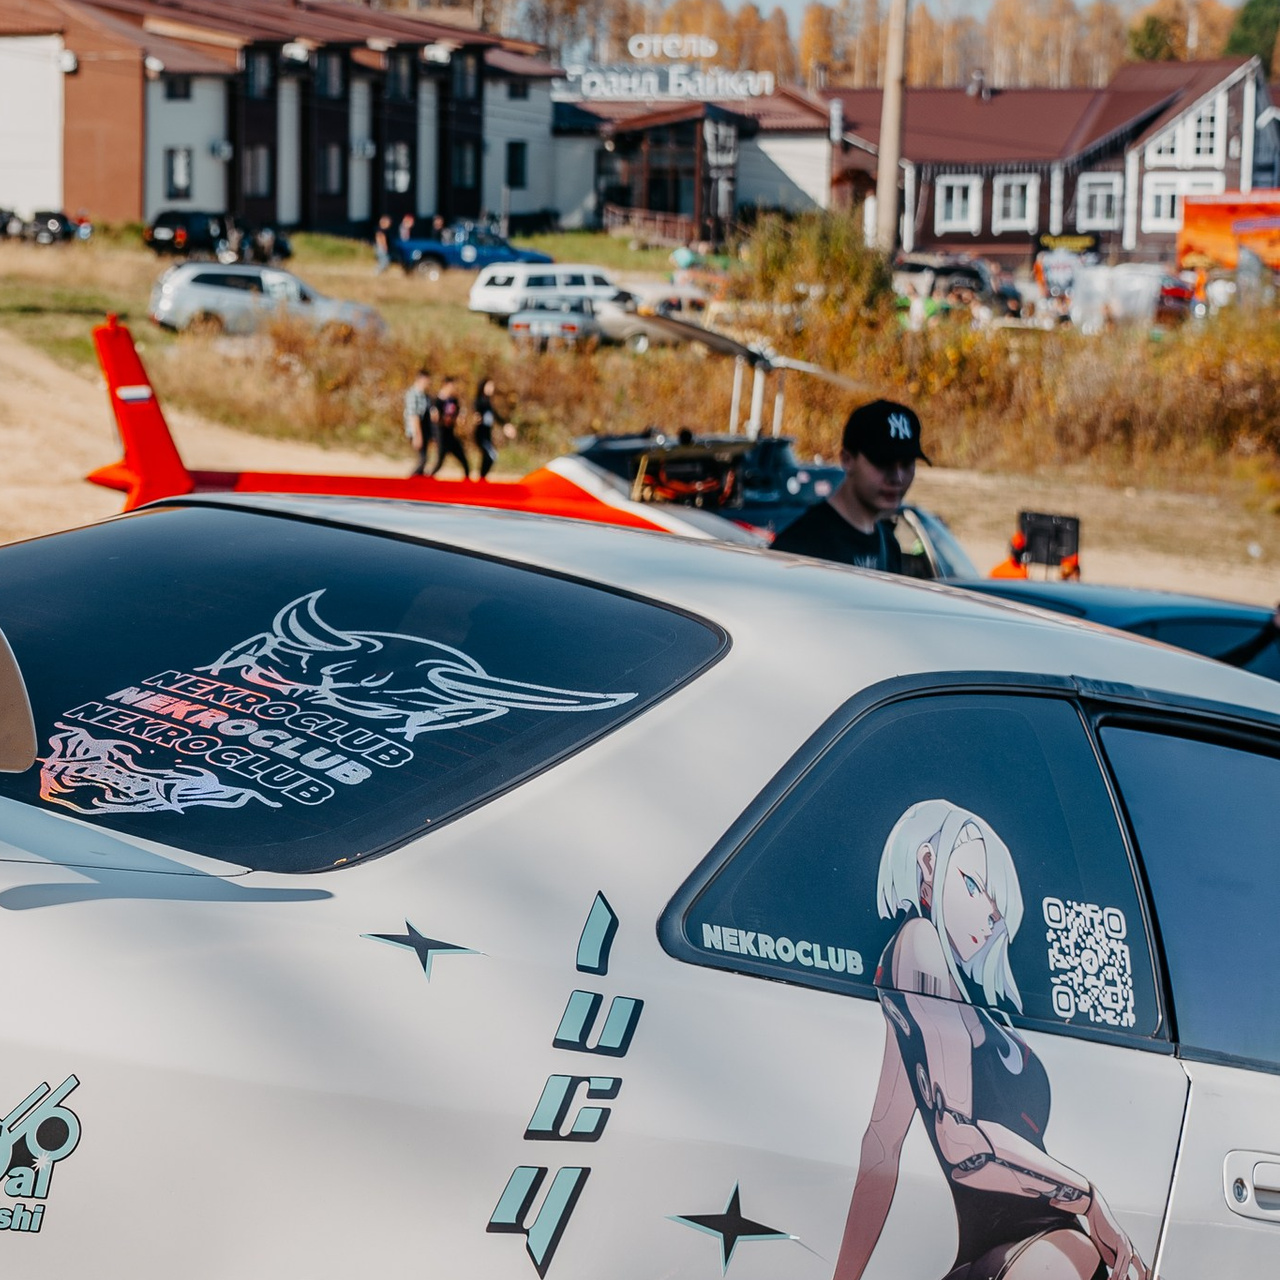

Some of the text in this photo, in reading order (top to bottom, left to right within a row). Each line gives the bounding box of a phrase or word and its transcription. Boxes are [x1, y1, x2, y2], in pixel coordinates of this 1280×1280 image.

[628, 33, 718, 58] отель
[668, 64, 774, 97] Байкал
[887, 412, 913, 440] NY
[105, 686, 373, 786] NEKROCLUB
[141, 669, 414, 768] NEKROCLUB
[62, 701, 335, 806] NEKROCLUB
[702, 923, 864, 976] NEKROCLUB
